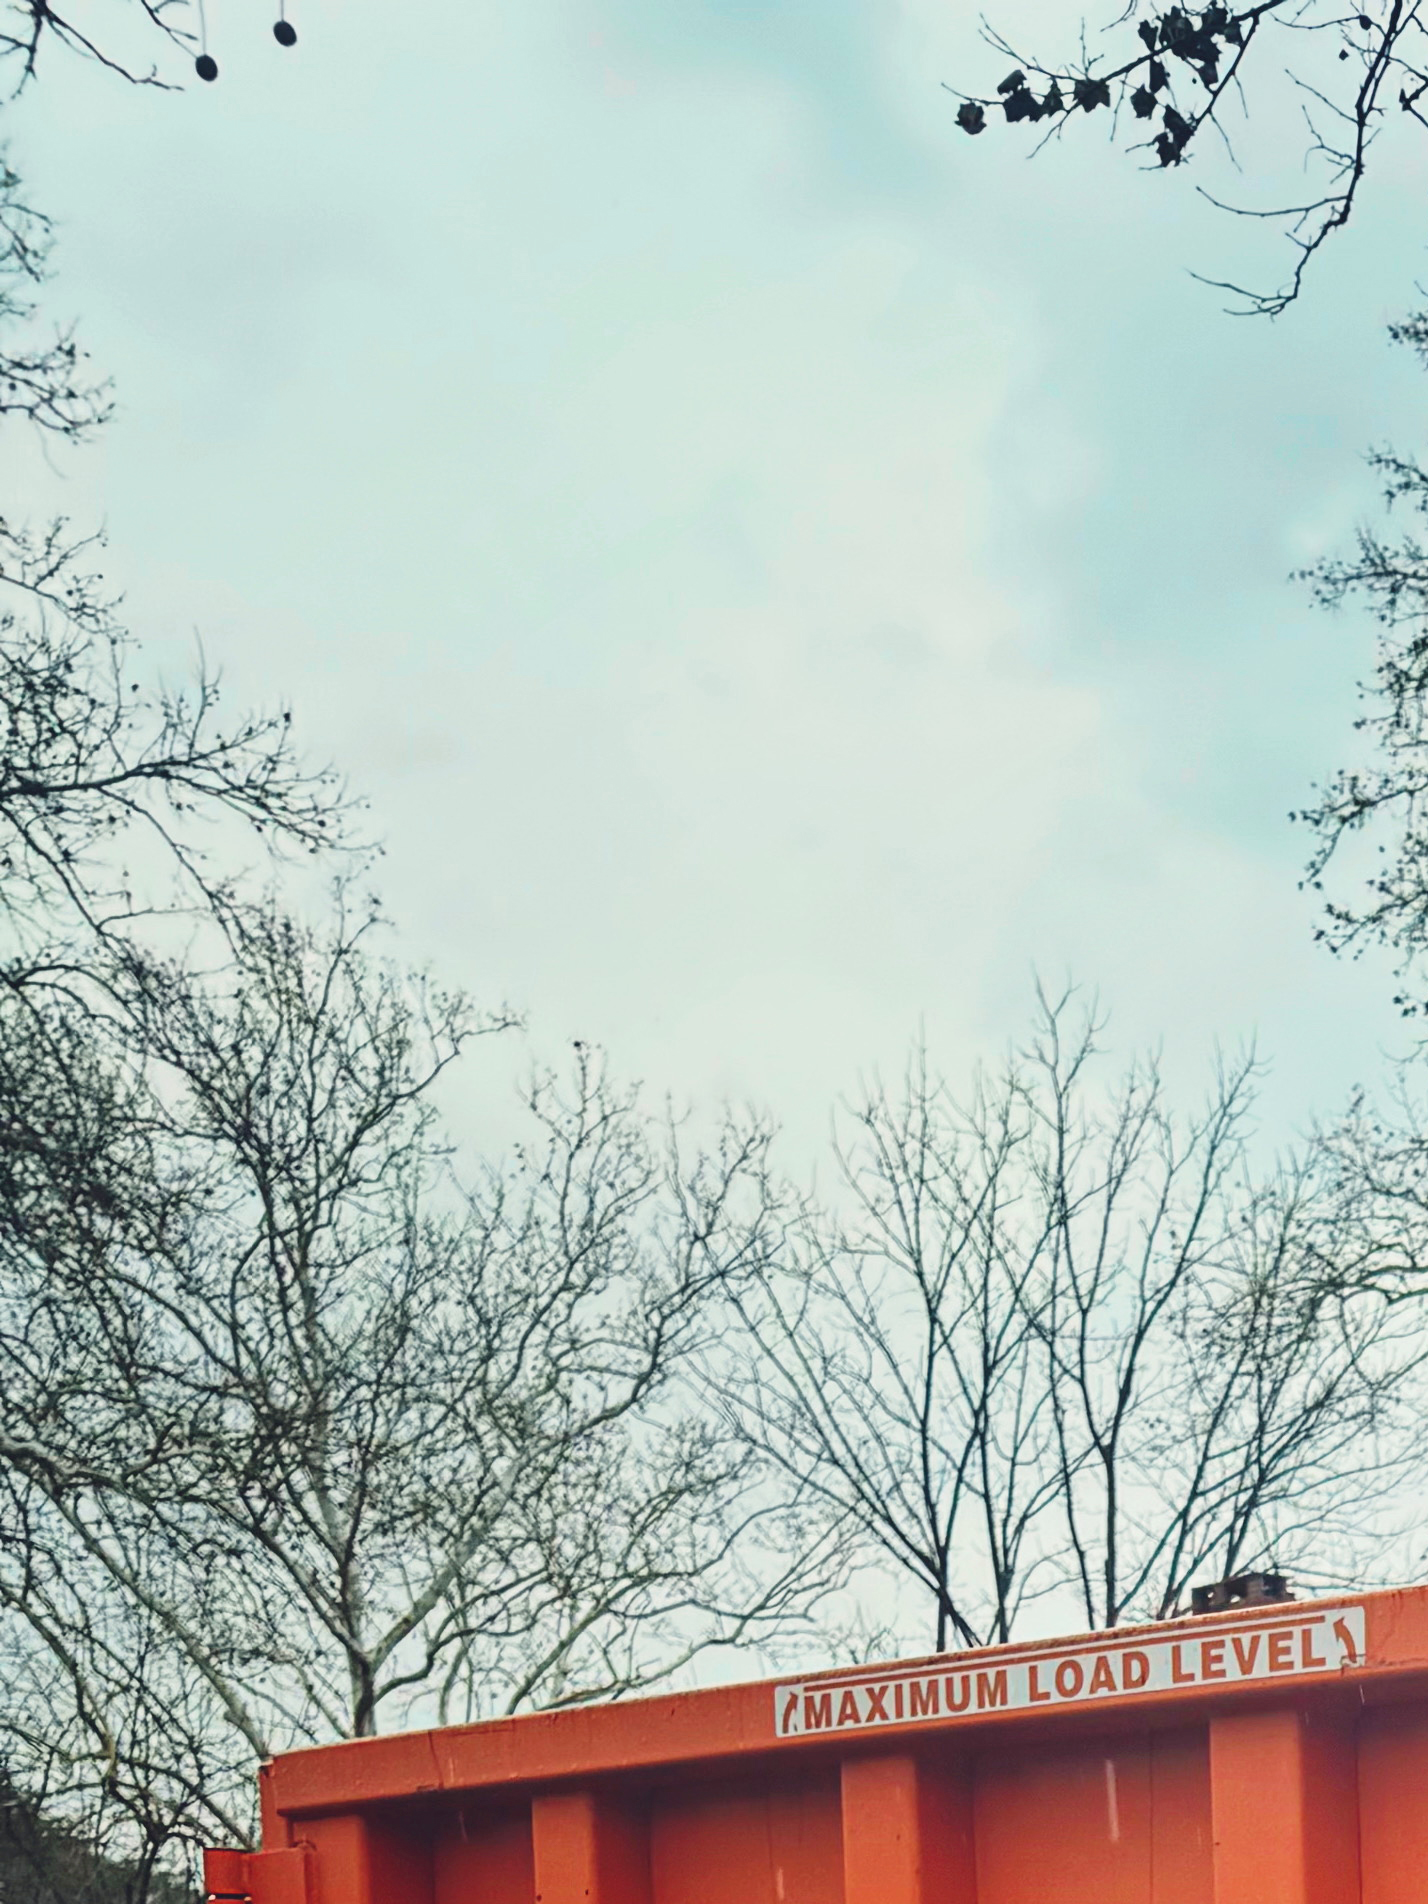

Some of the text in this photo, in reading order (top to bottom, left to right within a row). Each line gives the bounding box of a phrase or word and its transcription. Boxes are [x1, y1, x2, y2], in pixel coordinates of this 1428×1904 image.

[804, 1627, 1328, 1731] MAXIMUM LOAD LEVEL
